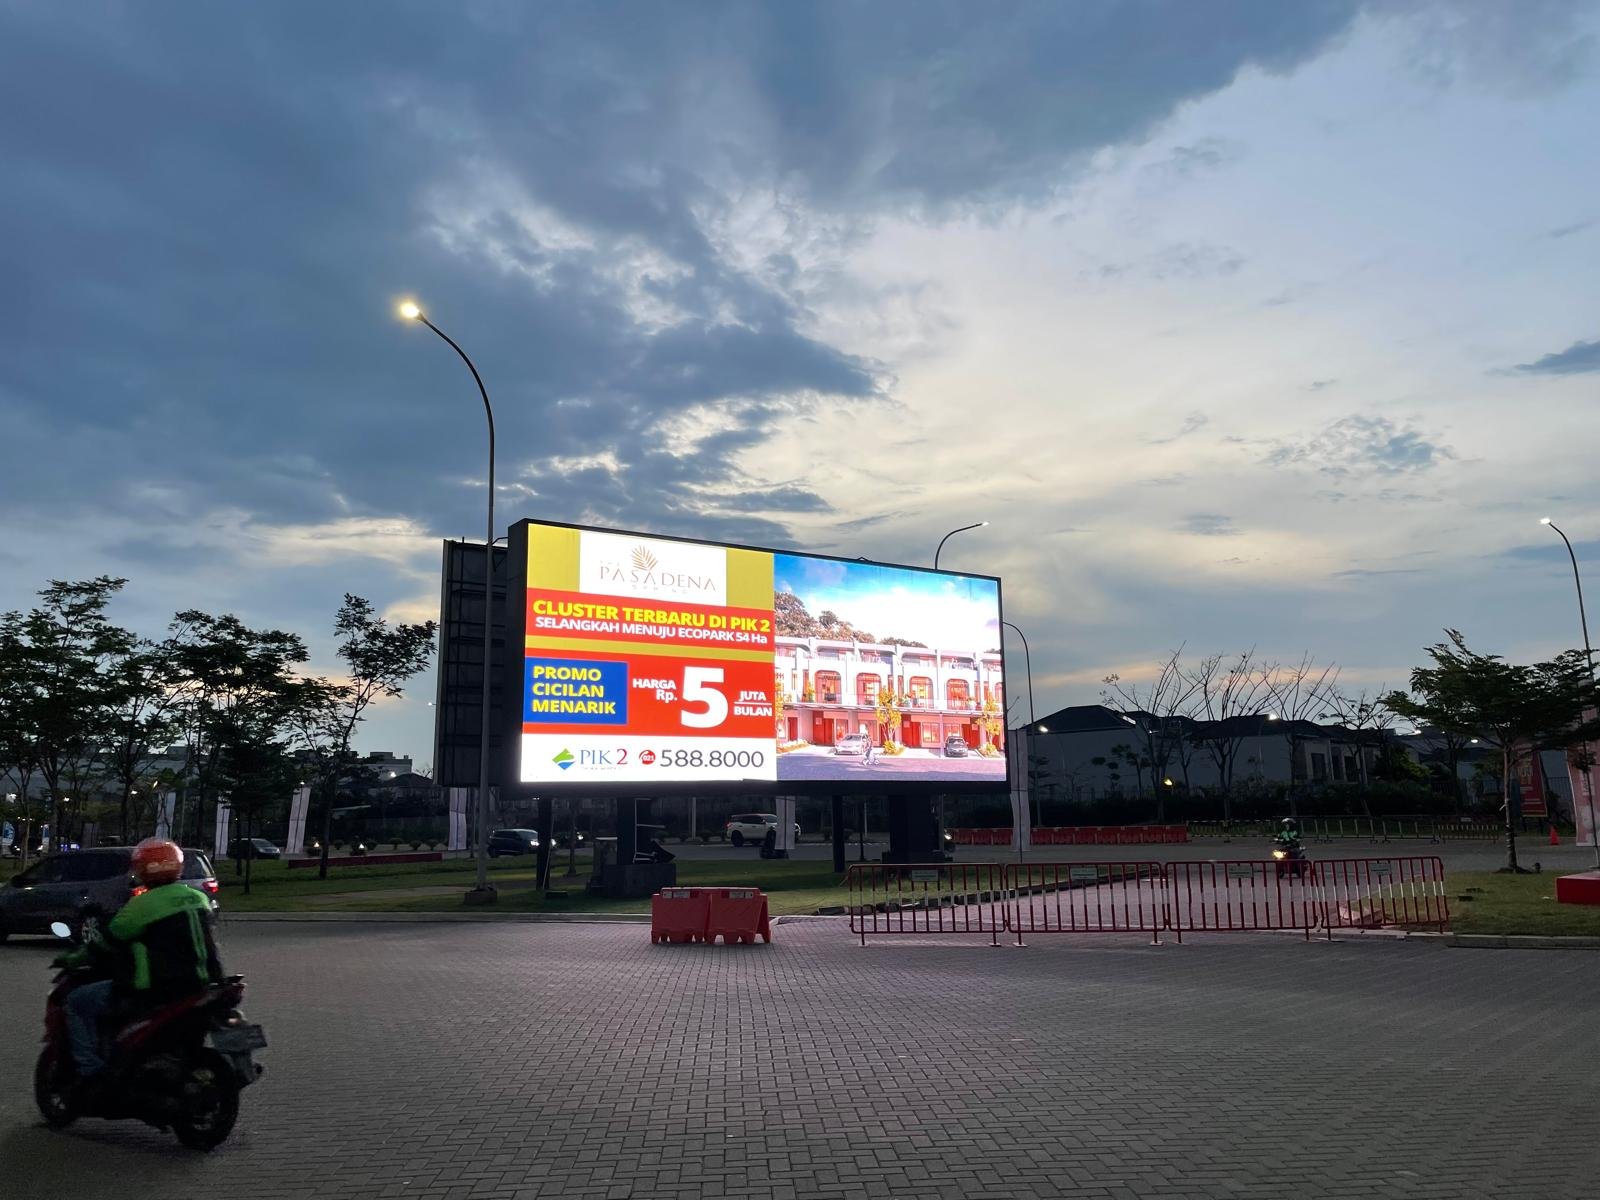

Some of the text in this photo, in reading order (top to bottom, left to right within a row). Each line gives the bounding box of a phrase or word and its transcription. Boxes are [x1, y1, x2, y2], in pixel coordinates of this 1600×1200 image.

[600, 566, 716, 591] PASADENA
[533, 600, 770, 632] CLUSTER TERBARU DI PIK 2
[536, 617, 768, 643] SELANGKAH MENUJU ECOPARK 54 Ha
[533, 666, 602, 681] PROMO
[533, 683, 604, 697] CICILAN
[633, 678, 676, 689] HARGA
[656, 689, 677, 703] Rp.
[680, 666, 728, 728] 5
[739, 691, 766, 701] JUTA
[532, 699, 616, 714] MENARIK
[734, 706, 772, 716] BULAN
[580, 749, 628, 765] PIK 2
[660, 750, 764, 768] 588.8000
